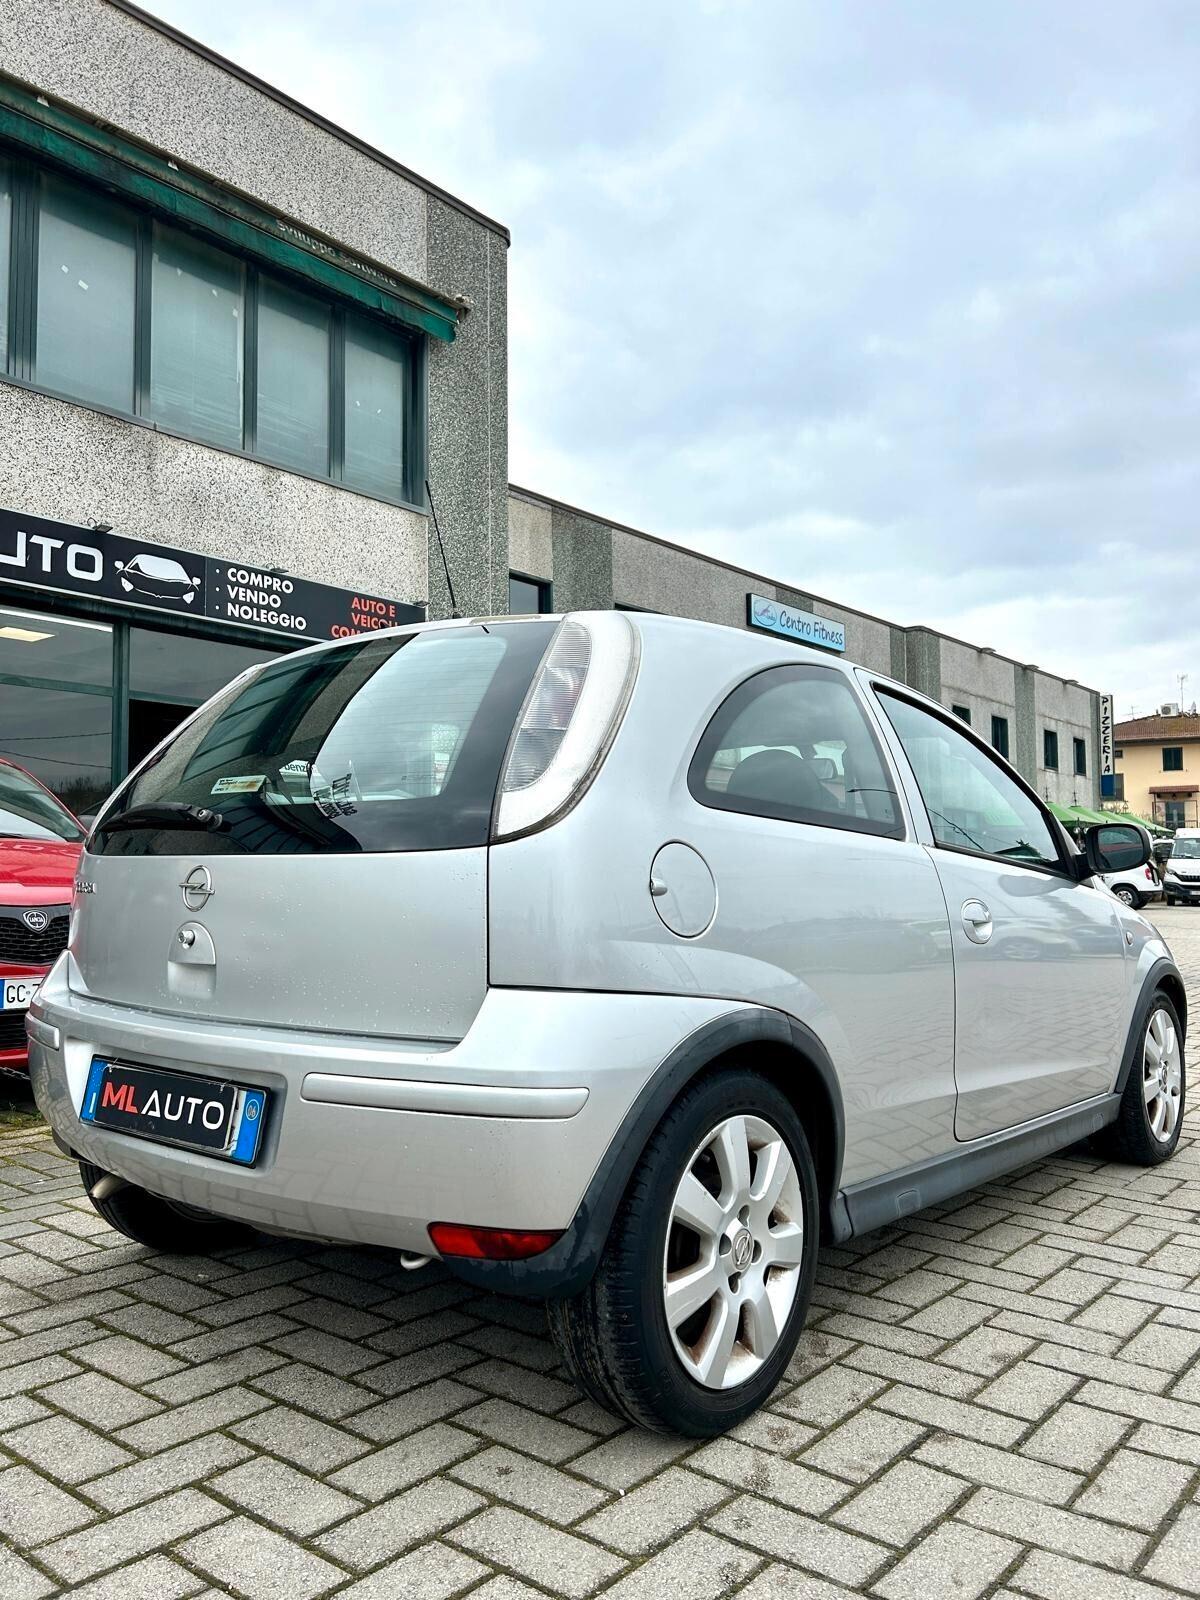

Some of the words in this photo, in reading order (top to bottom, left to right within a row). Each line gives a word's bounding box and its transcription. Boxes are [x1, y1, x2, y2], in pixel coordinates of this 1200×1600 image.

[227, 567, 294, 594] COMPRO
[226, 584, 282, 608] VENDO
[351, 596, 386, 615] AUTO
[389, 605, 396, 618] E
[227, 602, 307, 631] NOLEGGIO
[779, 610, 812, 635] Centro
[813, 621, 844, 646] Fitness
[1101, 696, 1111, 774] PIZZERIA
